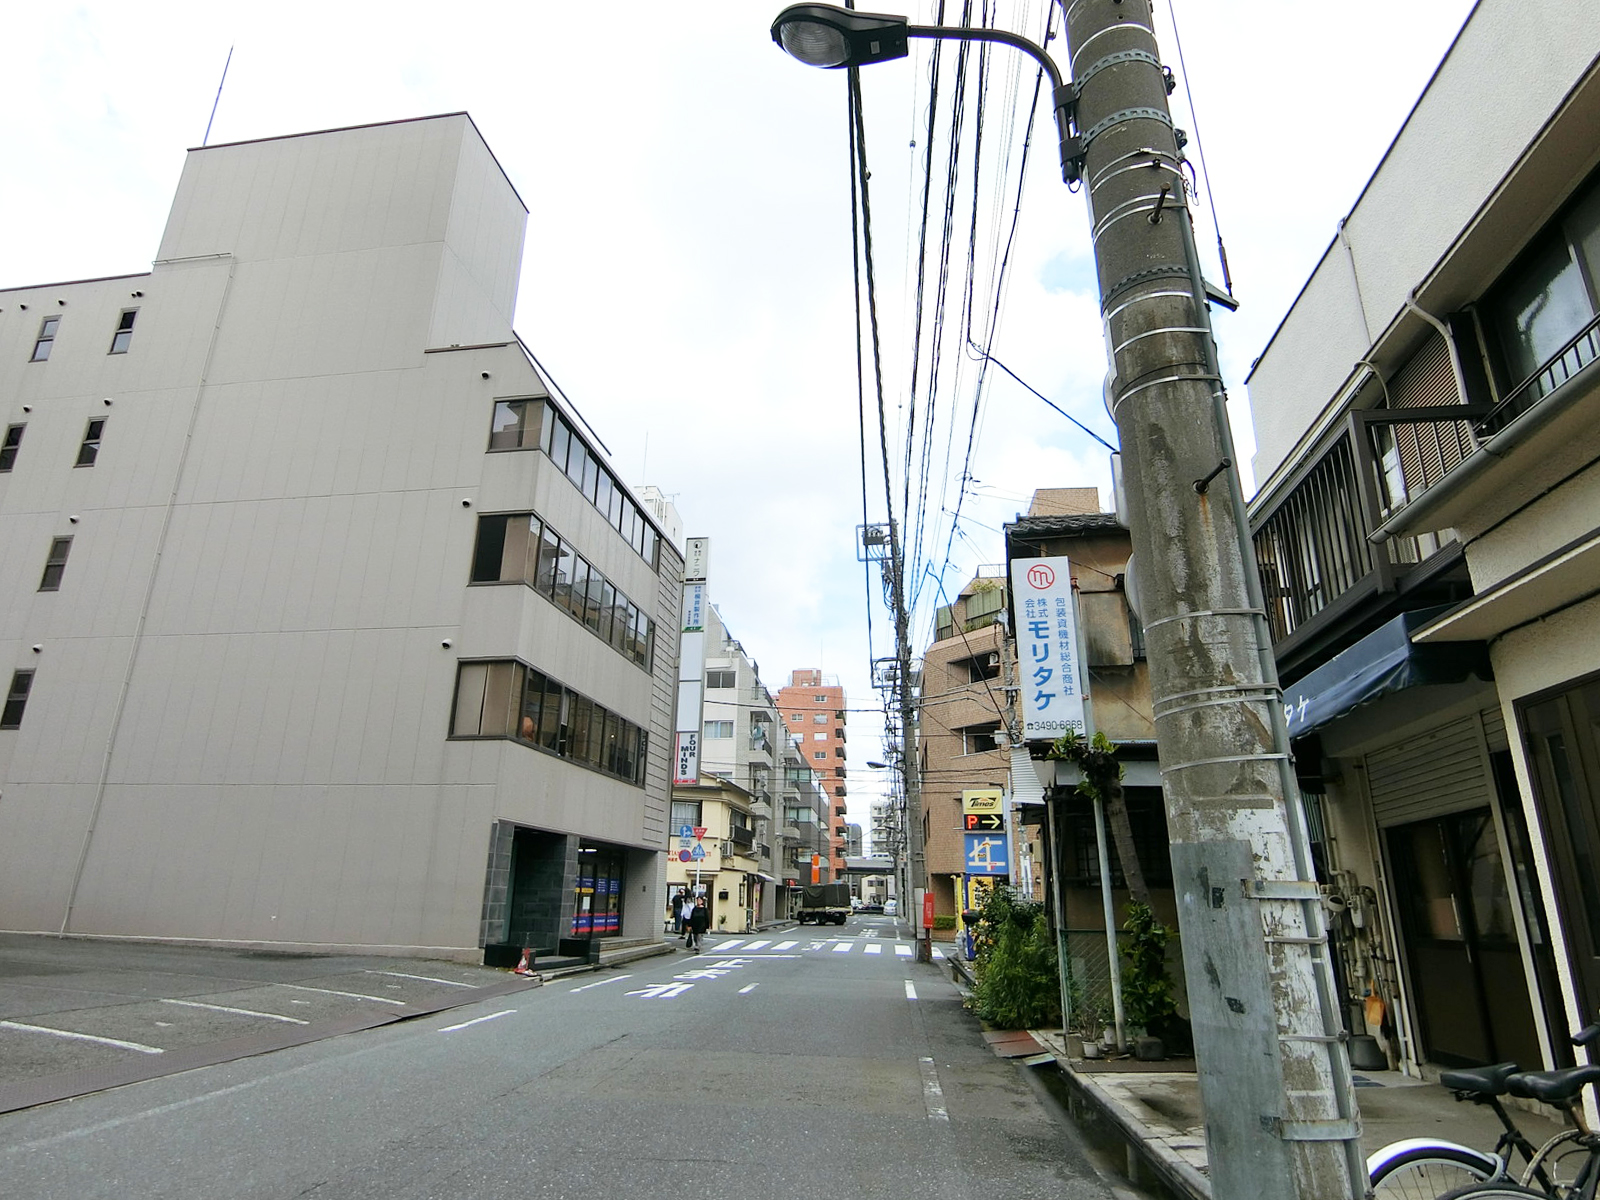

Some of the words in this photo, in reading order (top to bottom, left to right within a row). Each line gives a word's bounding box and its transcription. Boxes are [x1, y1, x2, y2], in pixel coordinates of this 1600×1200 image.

[1055, 597, 1074, 696] 包装資機材総合商社
[1028, 620, 1056, 711] モリタケ
[1034, 720, 1083, 731] 3490-6868
[680, 745, 689, 775] MINDS
[969, 797, 997, 808] Times
[967, 815, 978, 830] P
